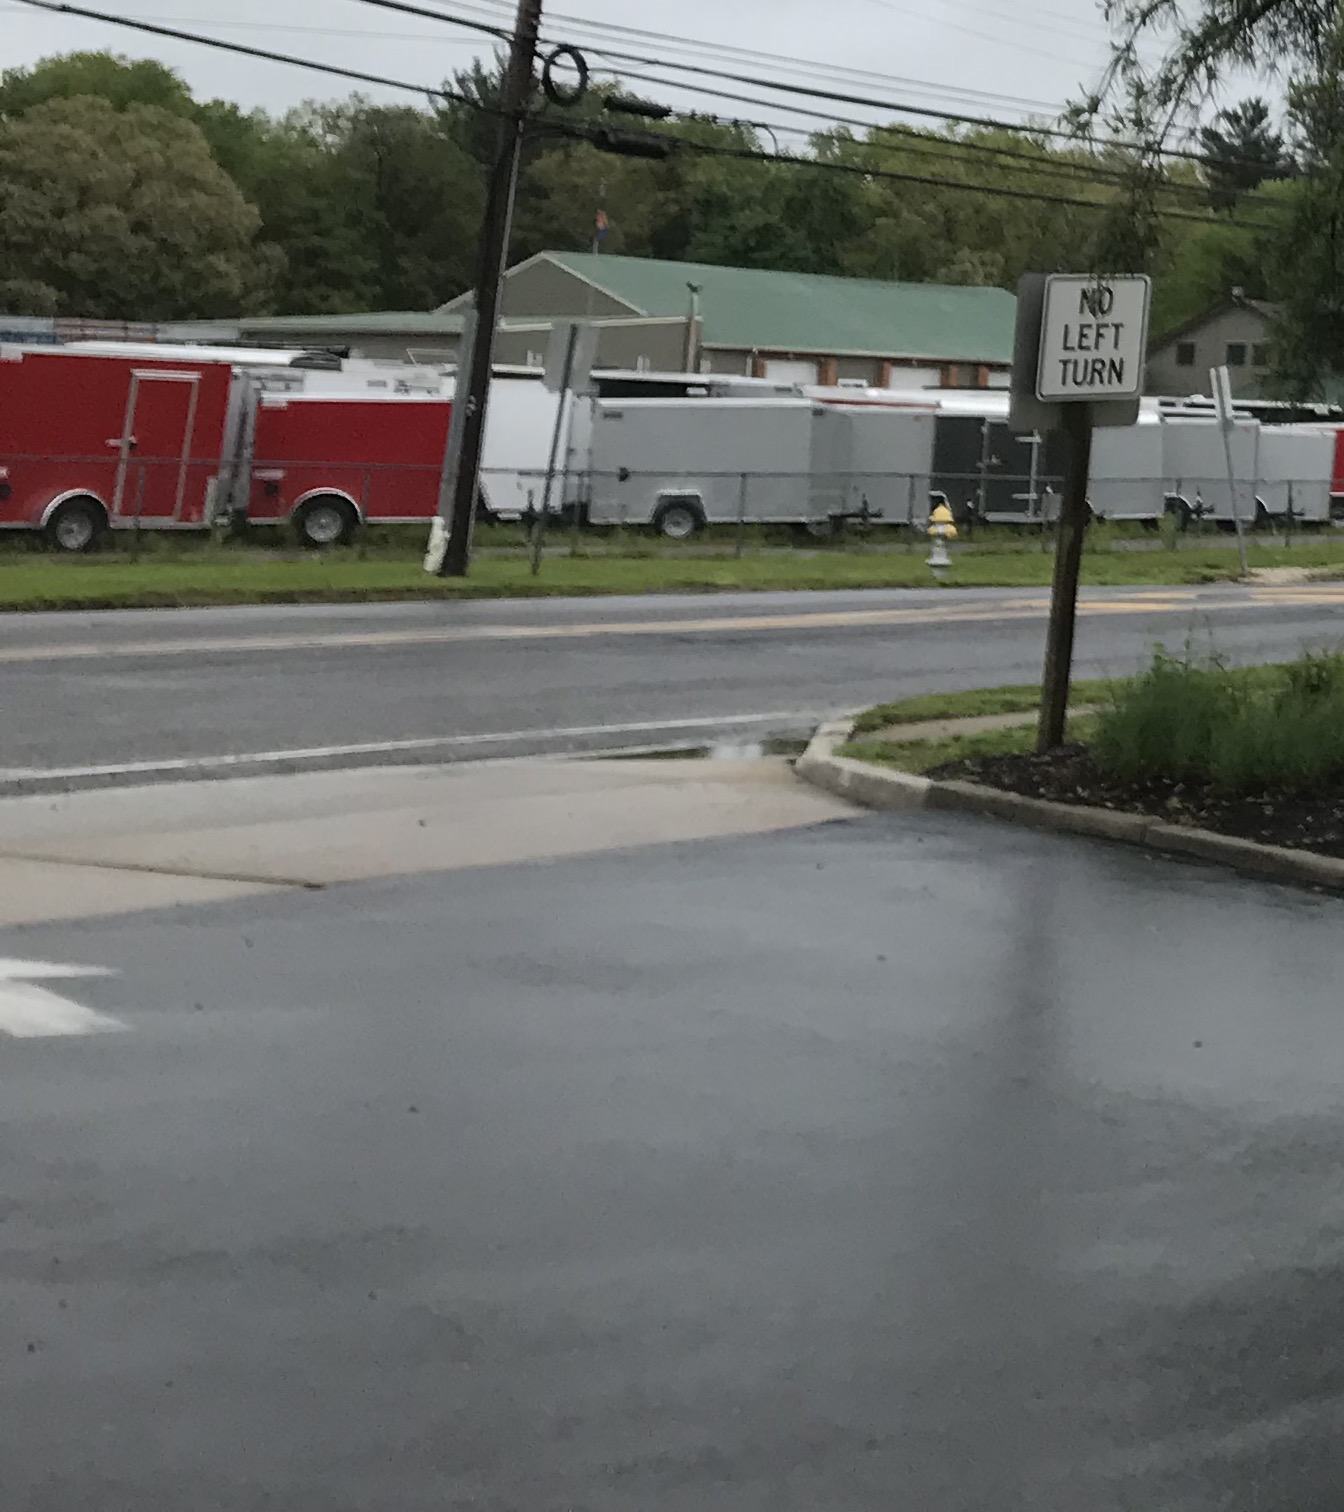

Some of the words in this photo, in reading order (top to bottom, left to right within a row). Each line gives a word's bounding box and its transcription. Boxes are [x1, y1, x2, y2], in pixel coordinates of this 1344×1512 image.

[1078, 286, 1114, 317] NO
[1061, 322, 1125, 352] LEFT
[1058, 356, 1125, 387] TURN
